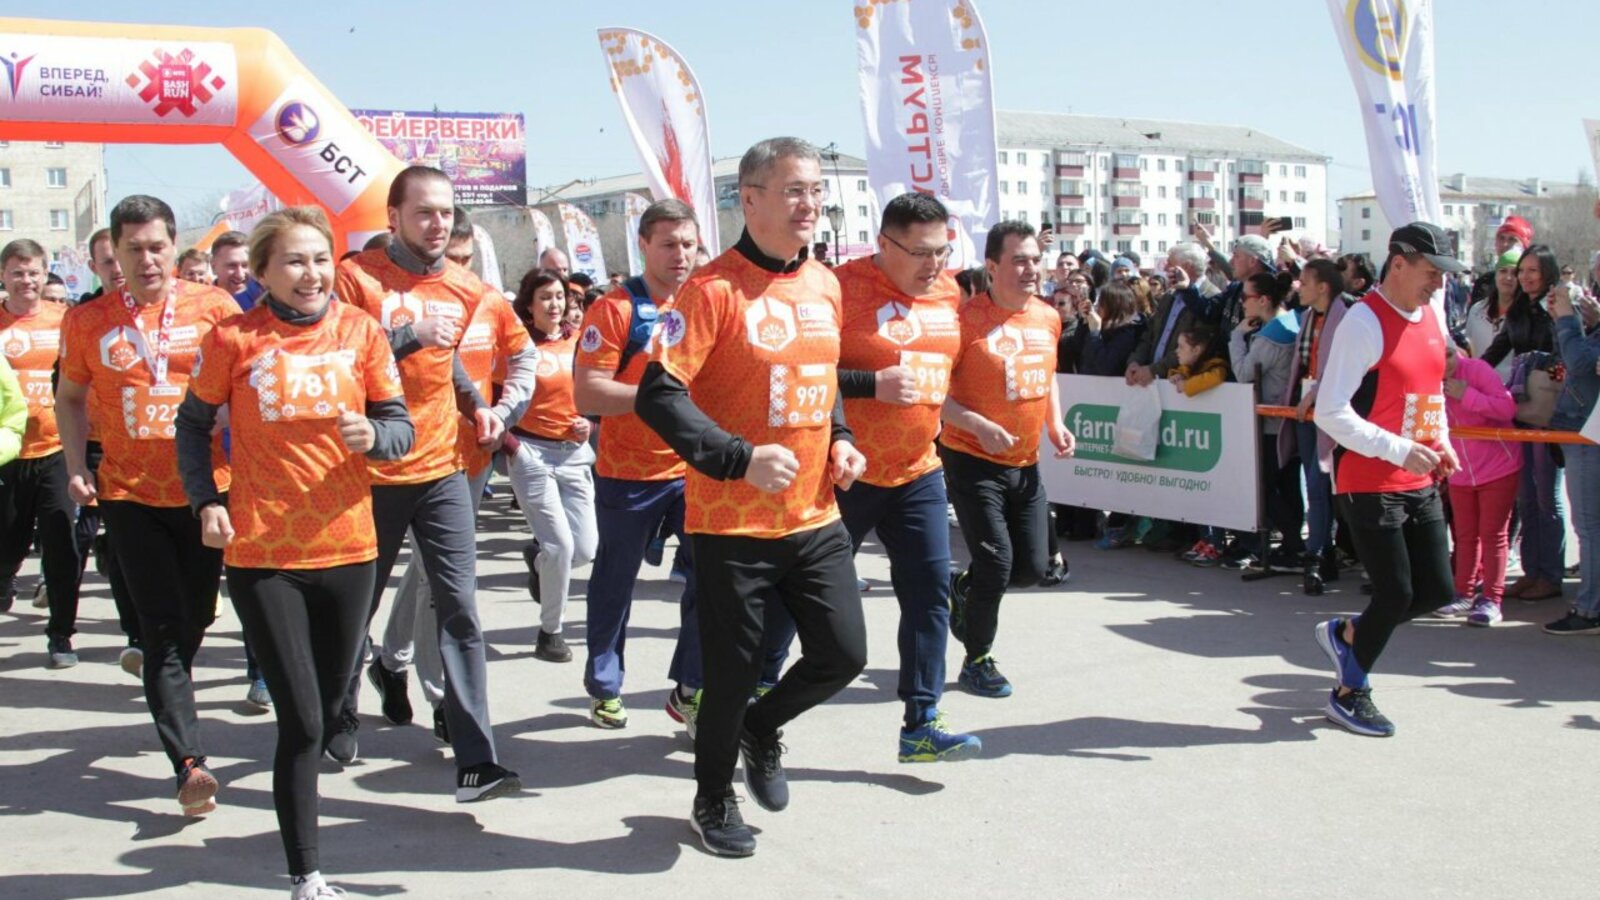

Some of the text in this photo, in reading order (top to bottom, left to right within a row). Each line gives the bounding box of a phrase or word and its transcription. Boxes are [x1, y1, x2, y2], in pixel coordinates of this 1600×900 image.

[40, 67, 109, 83] ВПЕРЕД,
[40, 83, 102, 97] СИБАЙ!
[163, 80, 190, 89] BASH
[163, 88, 189, 98] RUN
[319, 142, 366, 184] БСТ
[286, 370, 338, 399] 781
[916, 366, 947, 387] 919
[1022, 369, 1046, 385] 978
[796, 385, 828, 406] 997
[1074, 466, 1212, 492] БЫСТРО! УДОБНО! ВЫГОДНО!
